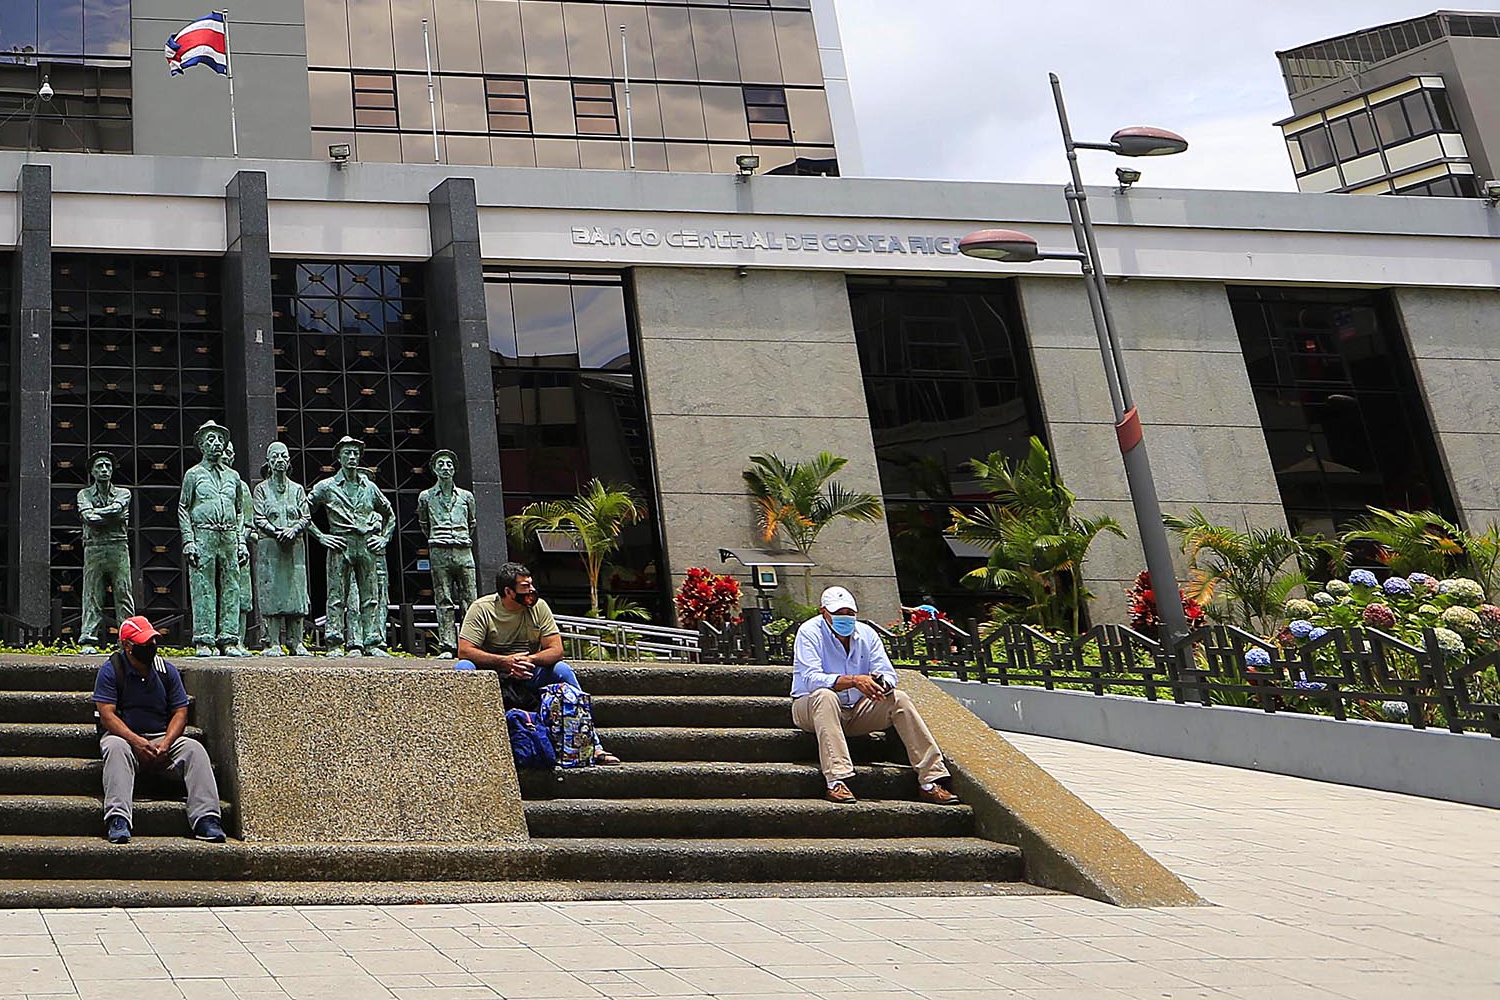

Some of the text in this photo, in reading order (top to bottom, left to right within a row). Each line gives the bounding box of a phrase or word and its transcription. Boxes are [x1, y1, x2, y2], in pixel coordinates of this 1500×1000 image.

[571, 226, 661, 246] BANCO
[666, 229, 782, 249] CENTRAL
[785, 232, 819, 251] DE
[821, 233, 907, 253] COSTA
